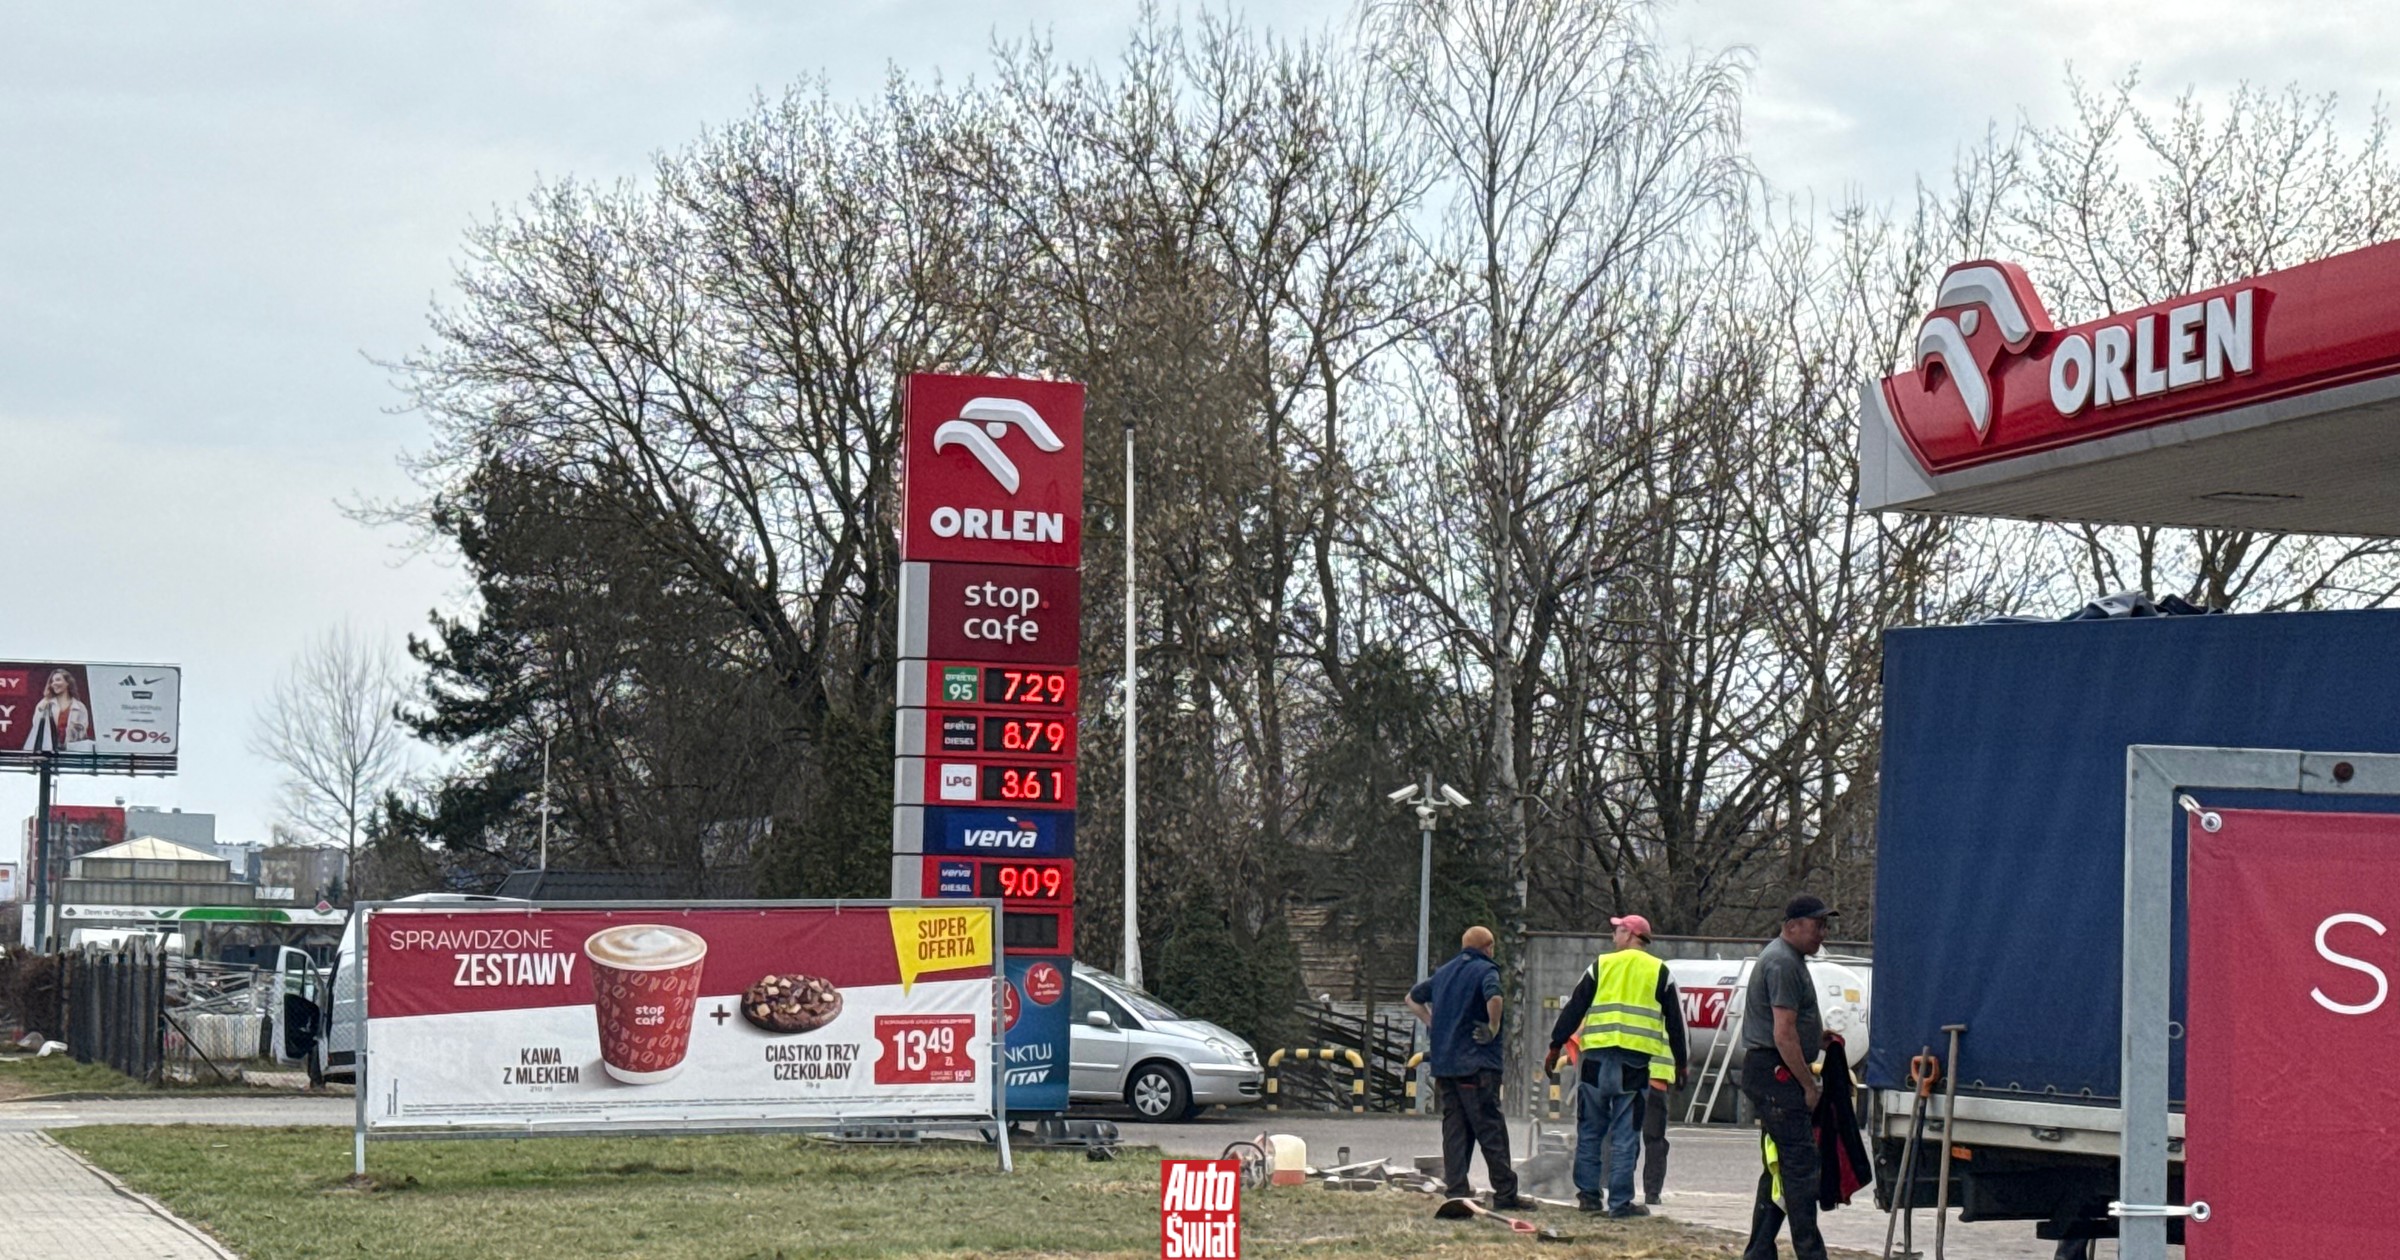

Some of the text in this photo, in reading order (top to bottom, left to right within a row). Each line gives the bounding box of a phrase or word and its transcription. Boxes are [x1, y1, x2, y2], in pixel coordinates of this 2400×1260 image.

[2049, 288, 2254, 418] ORLEN
[930, 506, 1064, 544] ORLEN
[963, 615, 1040, 645] cafe
[949, 683, 973, 700] 95
[1004, 672, 1065, 702] 7.29
[103, 728, 171, 744] -70%
[944, 737, 975, 746] DIESEL
[1004, 722, 1065, 751] 8.79
[946, 776, 972, 787] LPG
[1001, 770, 1062, 800] 3.61
[964, 829, 1038, 848] verva
[941, 869, 971, 878] verva
[1000, 867, 1061, 897] 9.09
[940, 883, 972, 892] DIESEL
[918, 917, 967, 939] SUPER
[389, 929, 554, 951] SPRAWDZONE
[918, 938, 975, 960] OFERTA
[453, 952, 577, 987] ZESTAWY
[2310, 912, 2388, 1015] S
[635, 1005, 665, 1016] stop
[635, 1015, 665, 1026] cafe
[521, 1047, 562, 1065] KAWA
[765, 1043, 860, 1062] CIASTKO TRZY
[1004, 1043, 1052, 1063] NKTUJ
[503, 1066, 580, 1084] Z MLEKIEM
[774, 1062, 852, 1081] CZEKOLADY
[529, 1085, 553, 1093] 210 ml
